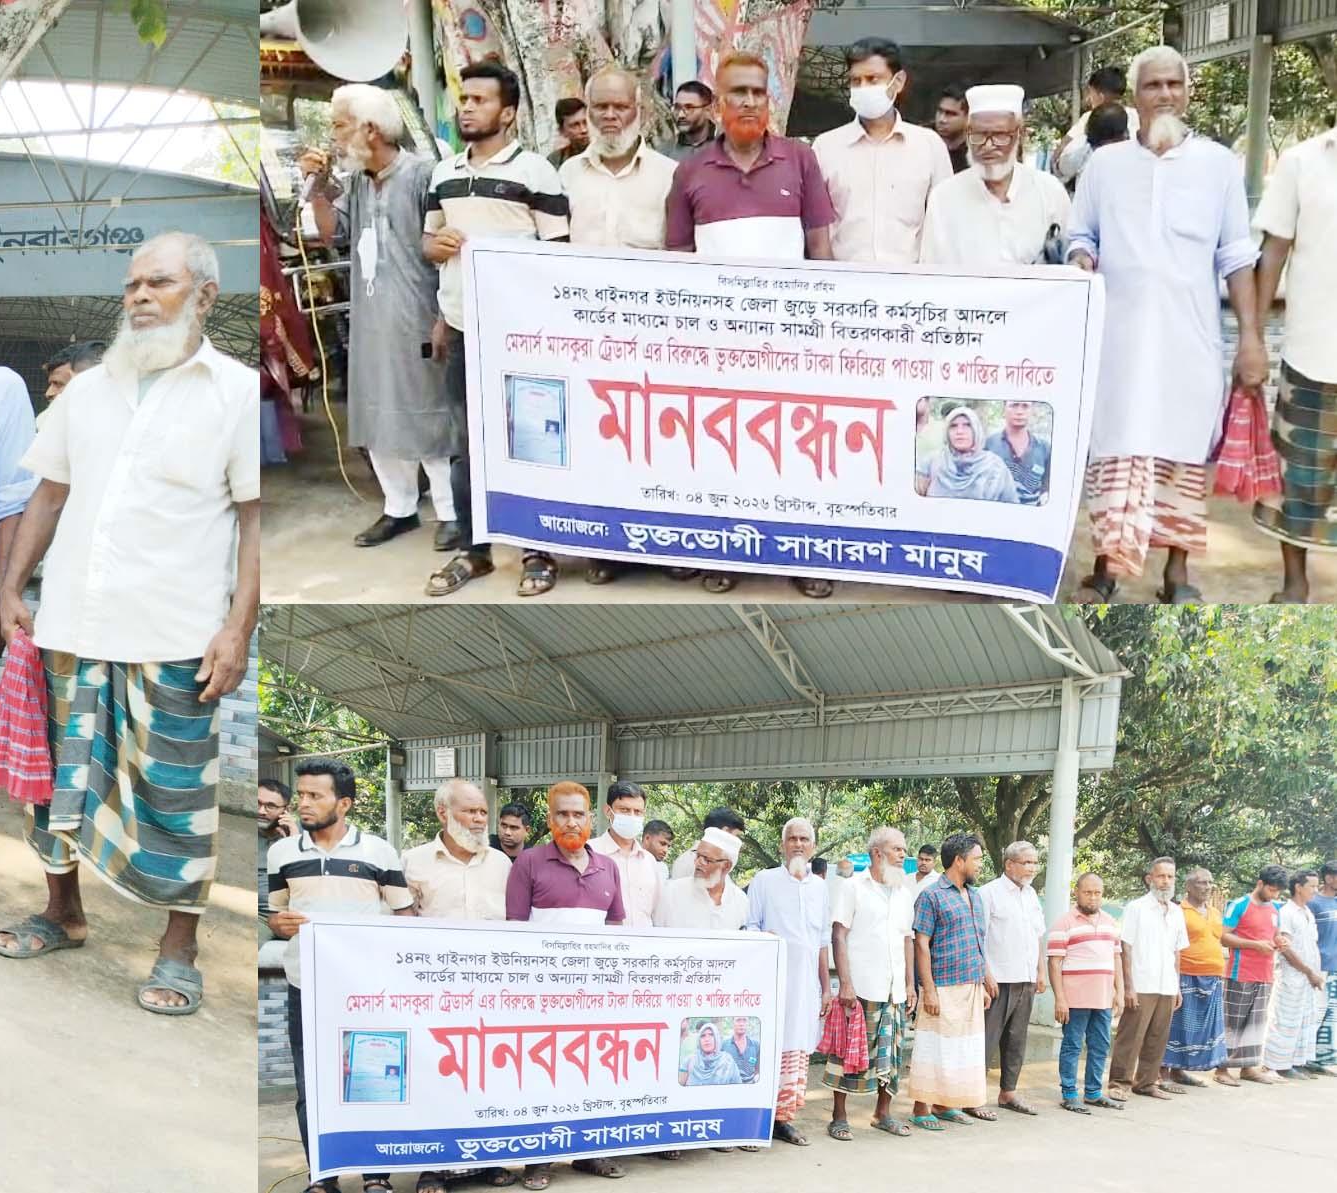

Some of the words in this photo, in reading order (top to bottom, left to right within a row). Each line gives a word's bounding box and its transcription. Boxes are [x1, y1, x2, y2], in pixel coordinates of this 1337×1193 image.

[553, 285, 589, 301] ১৪নং
[594, 285, 649, 304] ধাইনগর
[654, 288, 734, 311] ইউনিয়নসহ
[740, 297, 778, 312] জেলা
[783, 299, 817, 318] জুড়ে
[822, 298, 878, 318] সরকারি
[884, 300, 948, 325] কর্মসূচির
[953, 308, 1008, 324] আদলে
[572, 306, 616, 324] কার্ডের
[621, 312, 670, 328] মাধ্যমে
[674, 315, 700, 331] চাল
[706, 318, 717, 331] ও
[723, 319, 776, 335] অন্যান্য
[779, 318, 824, 338] সামগ্রী
[830, 320, 914, 344] বিতরণকারী
[920, 326, 983, 345] প্রতিষ্ঠান
[505, 329, 542, 352] মেসার্স
[546, 335, 593, 361] মাসকুরা
[598, 334, 638, 361] ট্রেডার্স
[643, 342, 662, 361] এর
[666, 336, 710, 365] বিরুদ্ধে
[714, 341, 800, 371] ভুক্তভোগীদের
[803, 348, 834, 372] টাকা
[838, 347, 886, 376] ফিরিয়ে
[891, 357, 934, 381] পাওয়া
[940, 362, 950, 380] ও
[957, 355, 999, 384] শাস্তির
[1005, 358, 1055, 385] দাবিতে
[587, 370, 897, 485] মানববন্ধন
[538, 514, 608, 536] আয়োজনে:
[620, 522, 763, 565] ভুক্তভোগী
[775, 535, 889, 564] সাধারণ
[903, 543, 986, 578] মানুষ
[396, 952, 431, 965] ১৪নং
[436, 950, 487, 966] ধাইনগর
[490, 951, 557, 968] ইউনিয়নসহ
[561, 956, 590, 967] জেলা
[593, 957, 619, 970] জুড়ে
[621, 954, 660, 968] সরকারি
[663, 955, 703, 972] কর্মসূচির
[705, 959, 736, 968] আদলে
[346, 990, 385, 1011] মেসার্স
[388, 994, 433, 1014] মাসকুরা
[438, 989, 473, 1012] ট্রেডার্স
[478, 994, 496, 1008] এর
[499, 988, 536, 1009] বিরুদ্ধে
[539, 988, 605, 1013] ভুক্তভোগীদের
[606, 991, 629, 1007] টাকা
[631, 989, 662, 1008] ফিরিয়ে
[665, 993, 692, 1006] পাওয়া
[695, 994, 702, 1006] ও
[705, 988, 731, 1007] শাস্তির
[733, 989, 761, 1007] দাবিতে
[427, 1016, 669, 1092] মানববন্ধন
[375, 1140, 445, 1156] আয়োজনে:
[455, 1125, 576, 1160] ভুক্তভোগী
[582, 1121, 663, 1144] সাধারণ
[668, 1118, 723, 1139] মানুষ
